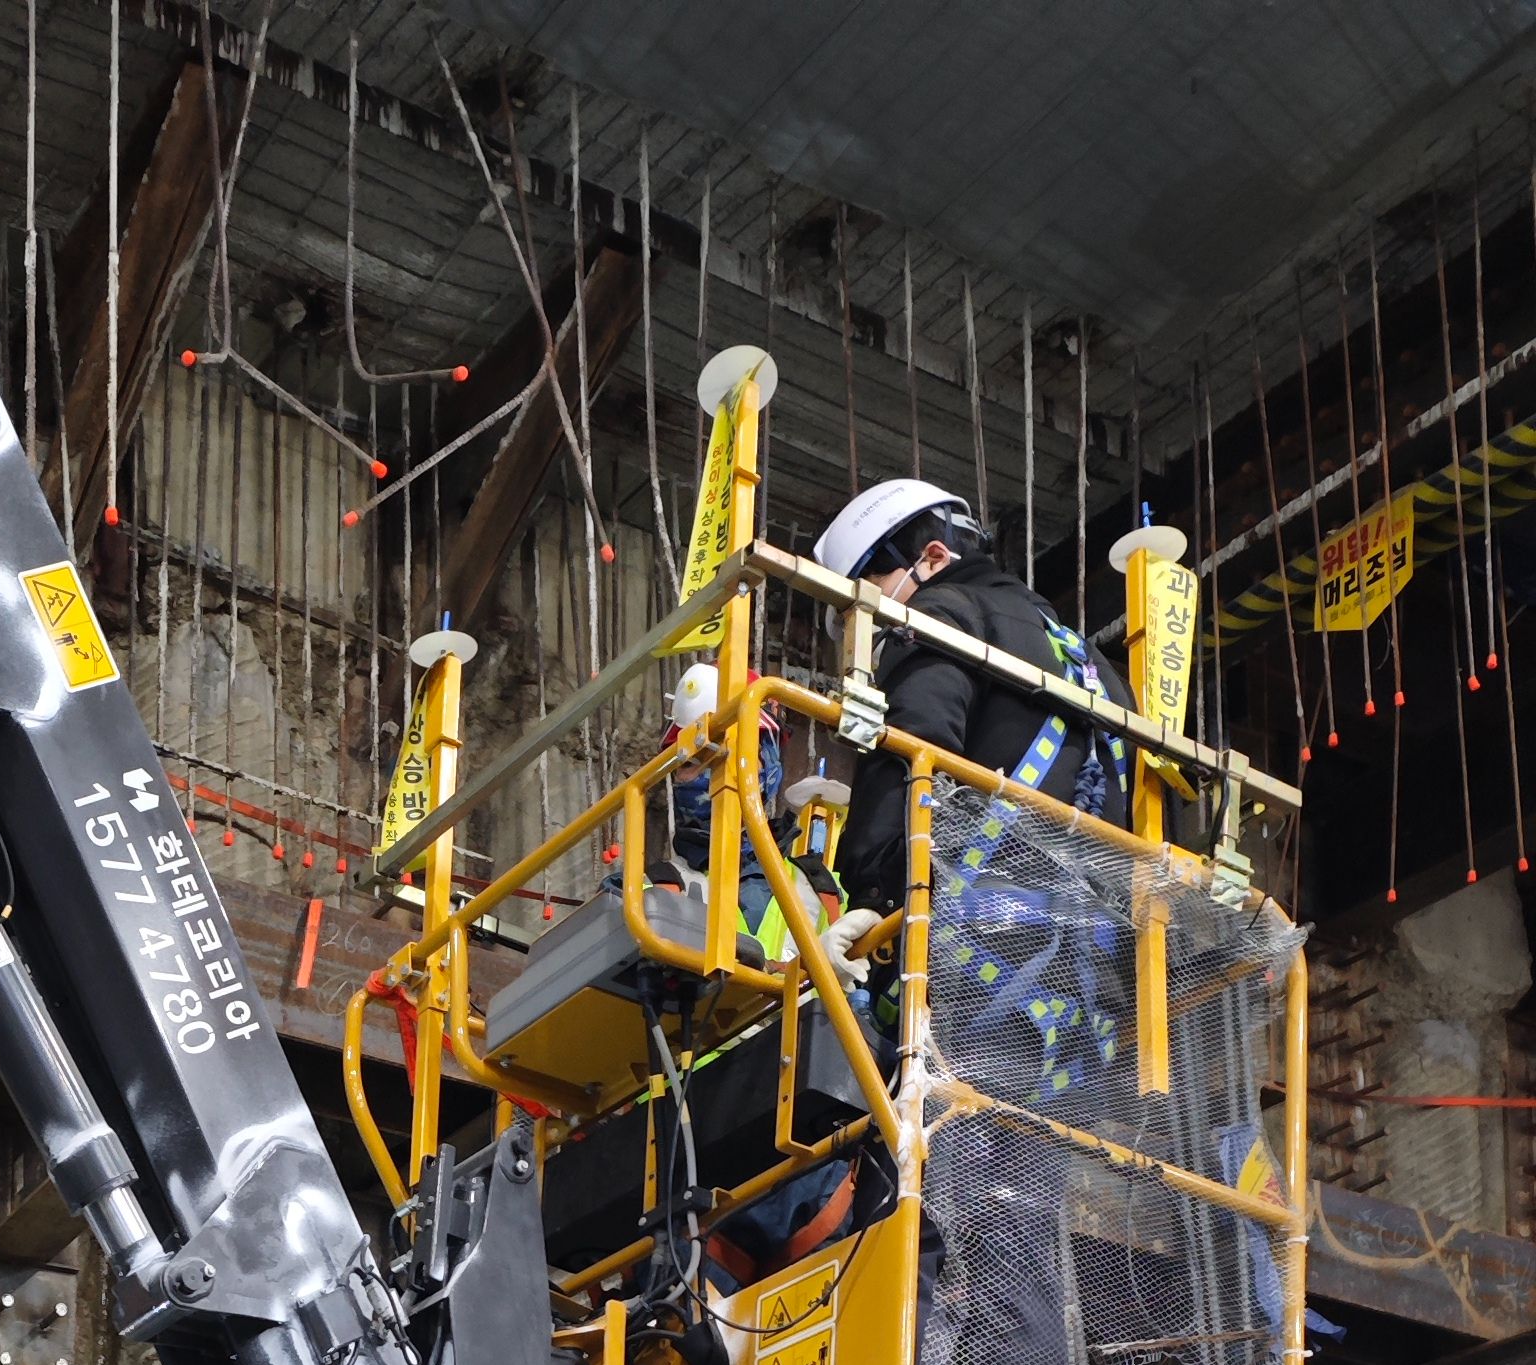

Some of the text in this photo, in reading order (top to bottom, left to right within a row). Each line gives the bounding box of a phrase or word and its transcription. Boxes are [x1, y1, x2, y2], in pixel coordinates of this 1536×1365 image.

[74, 782, 216, 1055] 1577 4780
[148, 830, 261, 1040] 화테코리아
